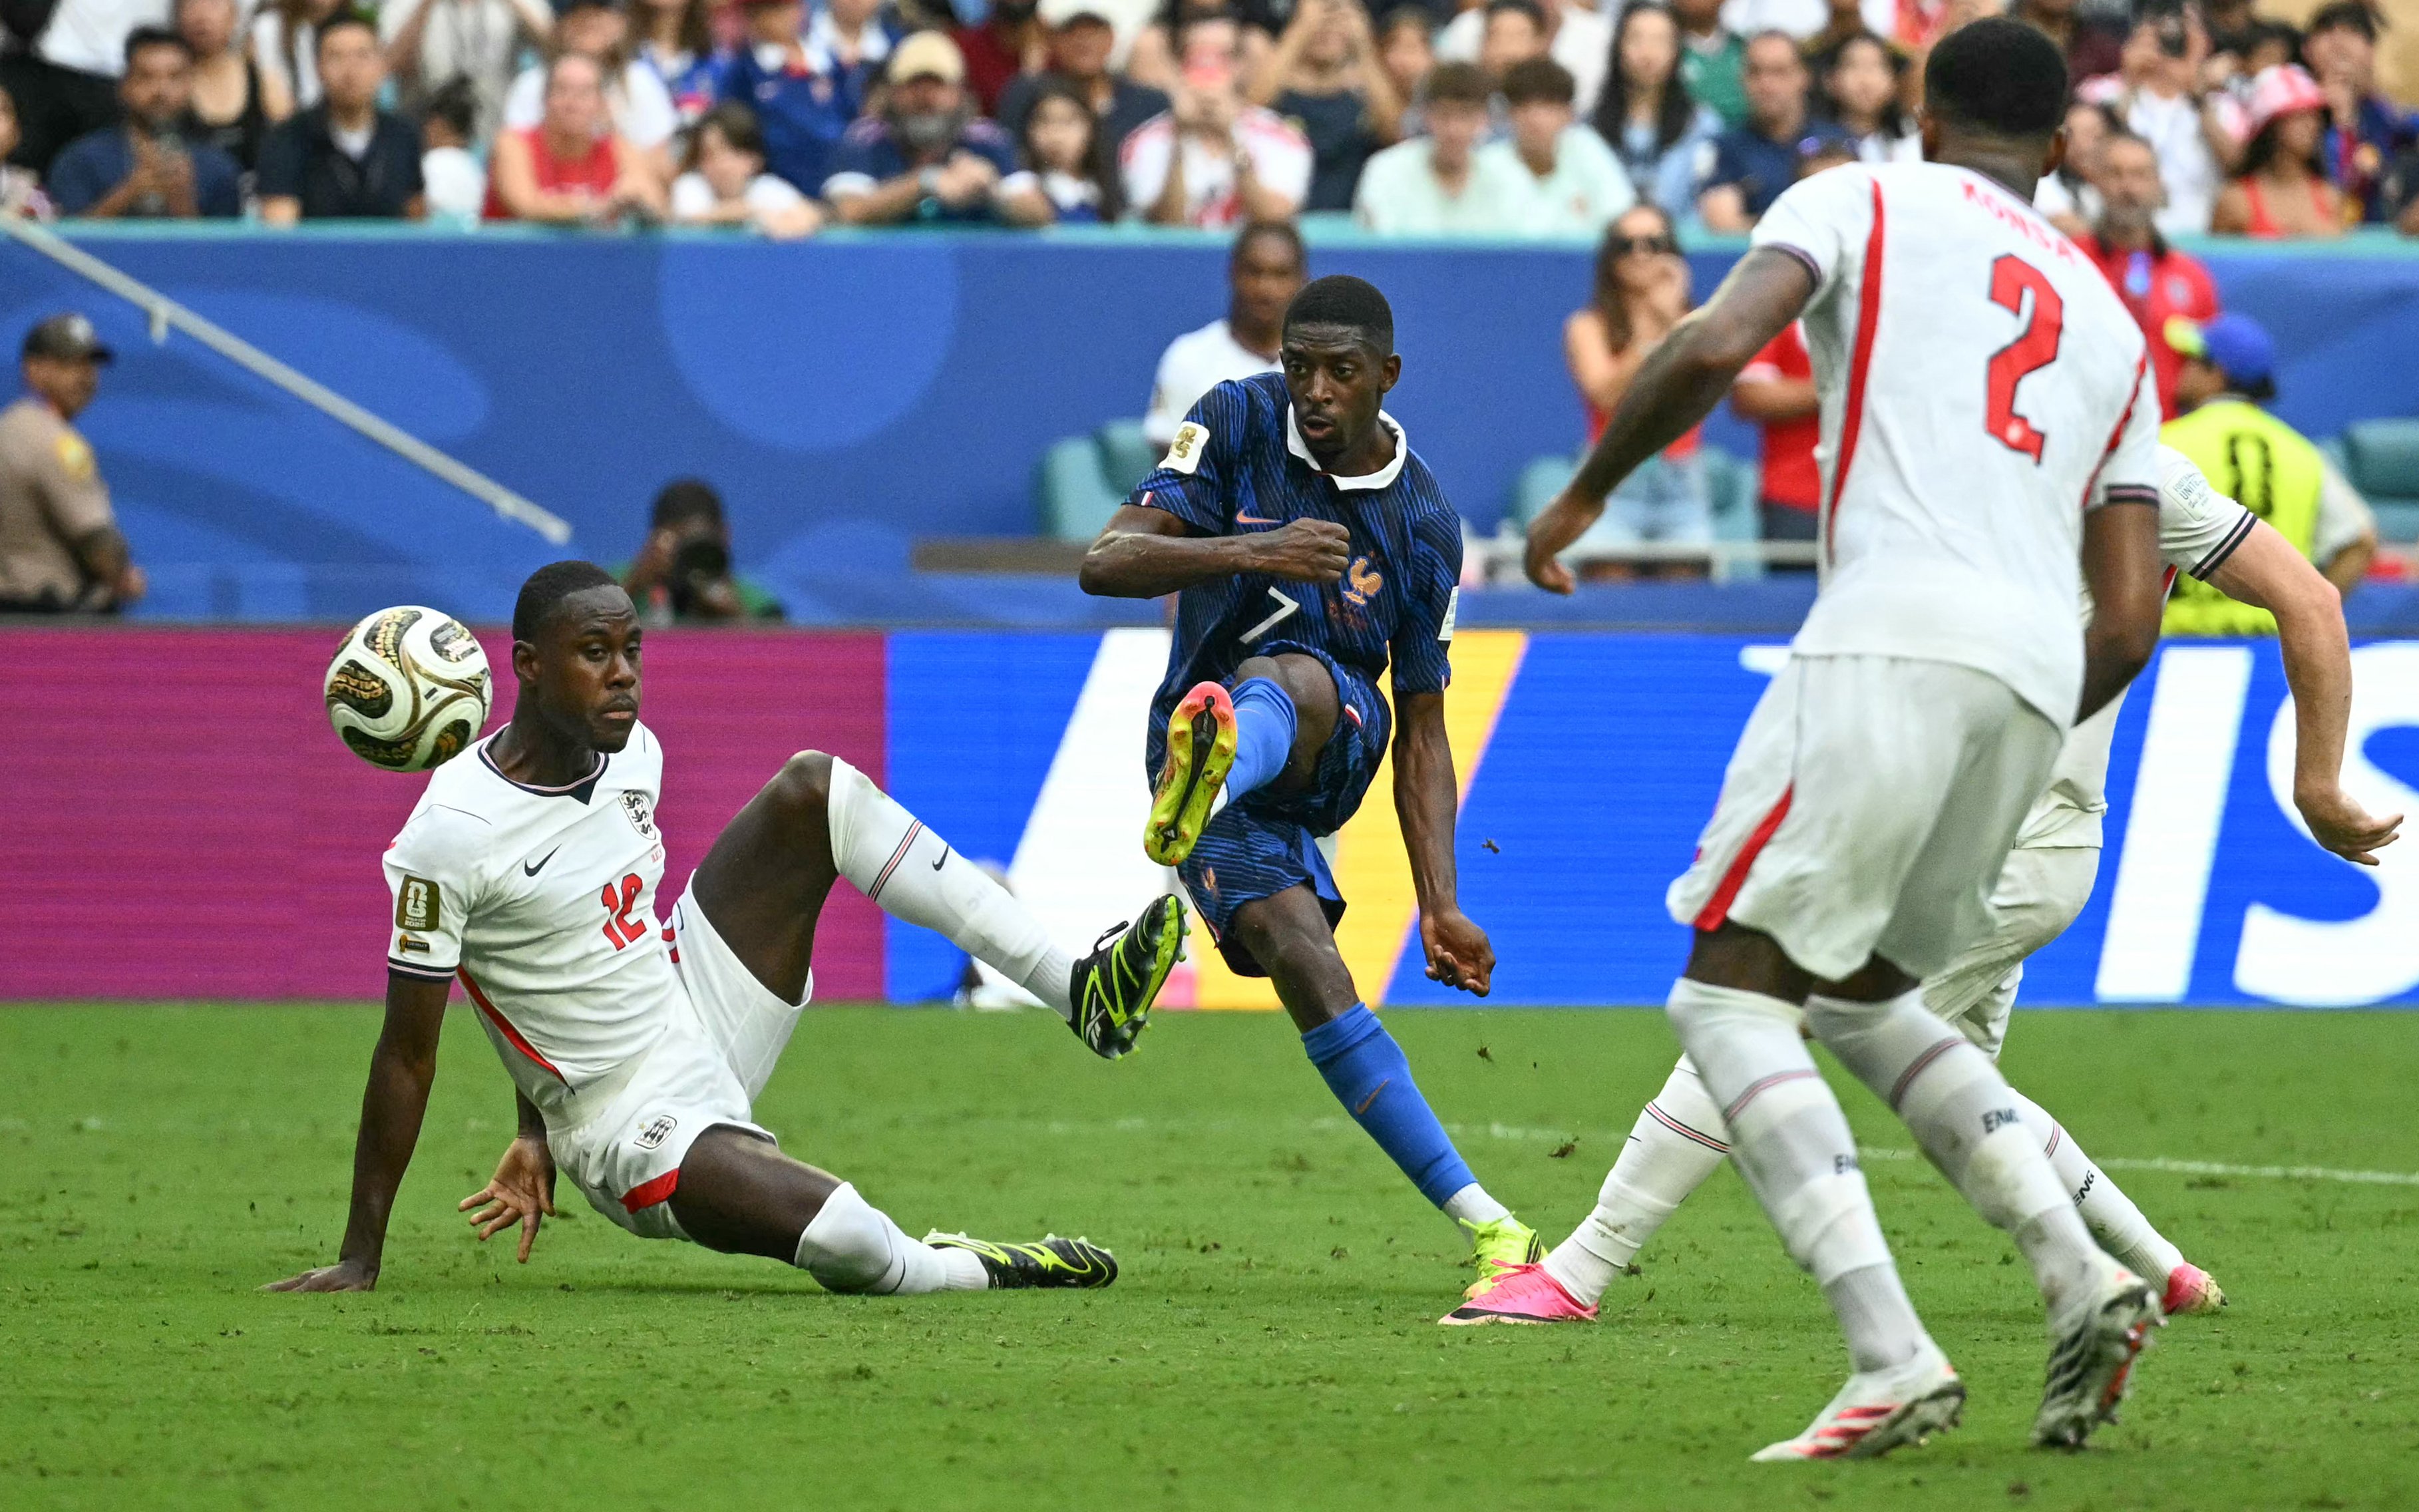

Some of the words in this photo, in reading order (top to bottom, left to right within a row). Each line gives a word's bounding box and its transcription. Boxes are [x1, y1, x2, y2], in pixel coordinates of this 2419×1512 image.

[1984, 252, 2064, 467] 2
[1238, 586, 1300, 644] 7
[601, 872, 647, 952] 12
[2073, 1170, 2094, 1207] ENG
